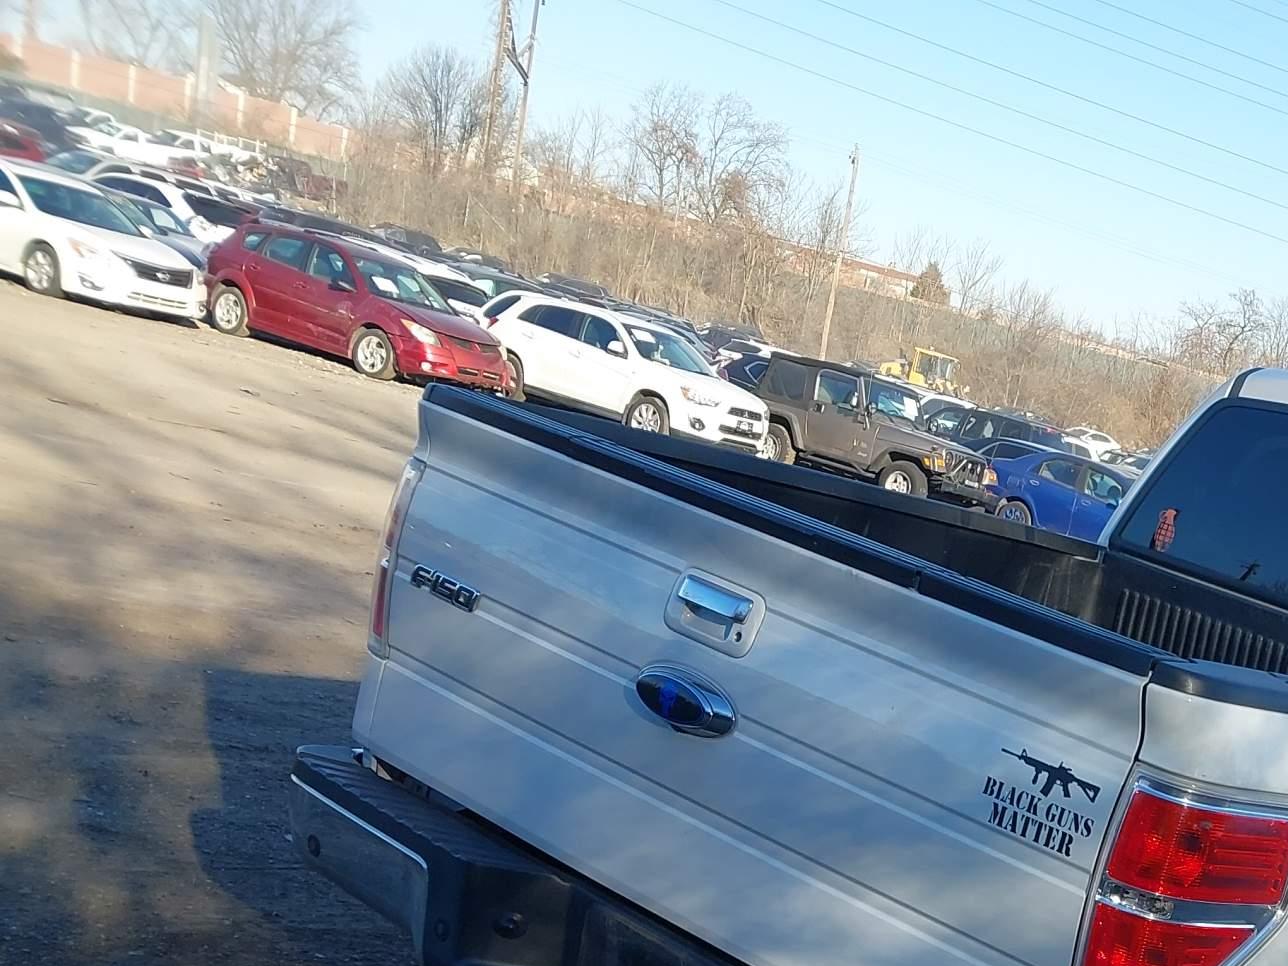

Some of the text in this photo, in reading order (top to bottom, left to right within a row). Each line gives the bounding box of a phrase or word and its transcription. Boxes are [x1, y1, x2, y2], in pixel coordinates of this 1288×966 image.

[982, 776, 1095, 838] BLACK GUNS
[988, 802, 1074, 857] MATTER
